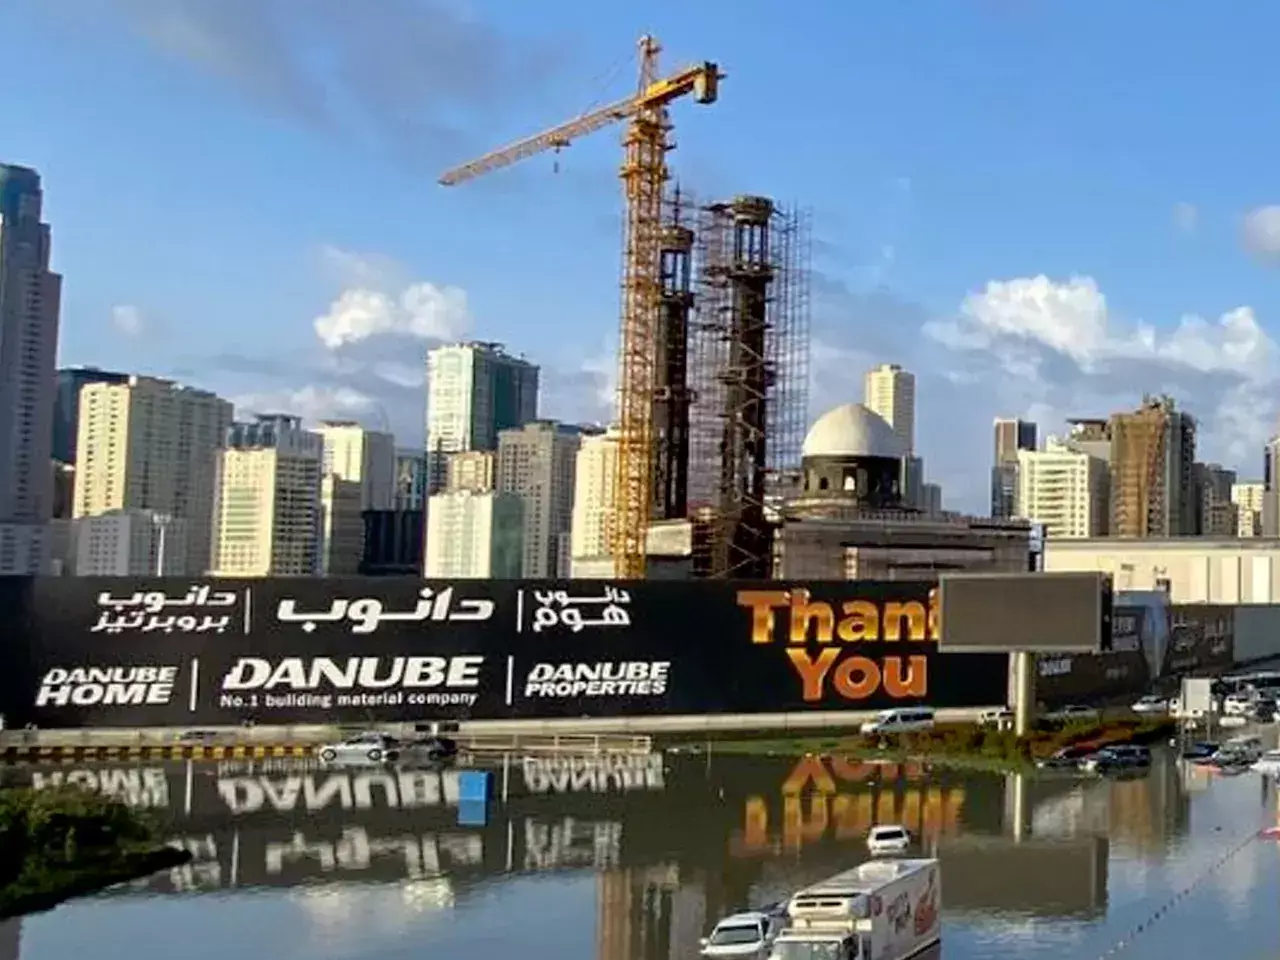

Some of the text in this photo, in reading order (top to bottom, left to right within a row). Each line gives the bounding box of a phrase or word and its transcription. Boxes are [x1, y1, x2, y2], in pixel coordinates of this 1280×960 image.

[97, 585, 237, 612] دانوب
[277, 587, 495, 633] دانوب
[90, 611, 229, 632] بروبرتيز
[533, 604, 631, 632] هوم
[43, 666, 178, 685] DANUBE
[222, 656, 485, 690] DANUBE
[527, 661, 671, 682] DANUBE
[785, 647, 928, 701] You
[34, 683, 174, 706] HOME
[525, 679, 666, 697] PROPERTIES
[265, 693, 332, 708] building
[337, 693, 402, 705] material
[408, 693, 478, 706] company
